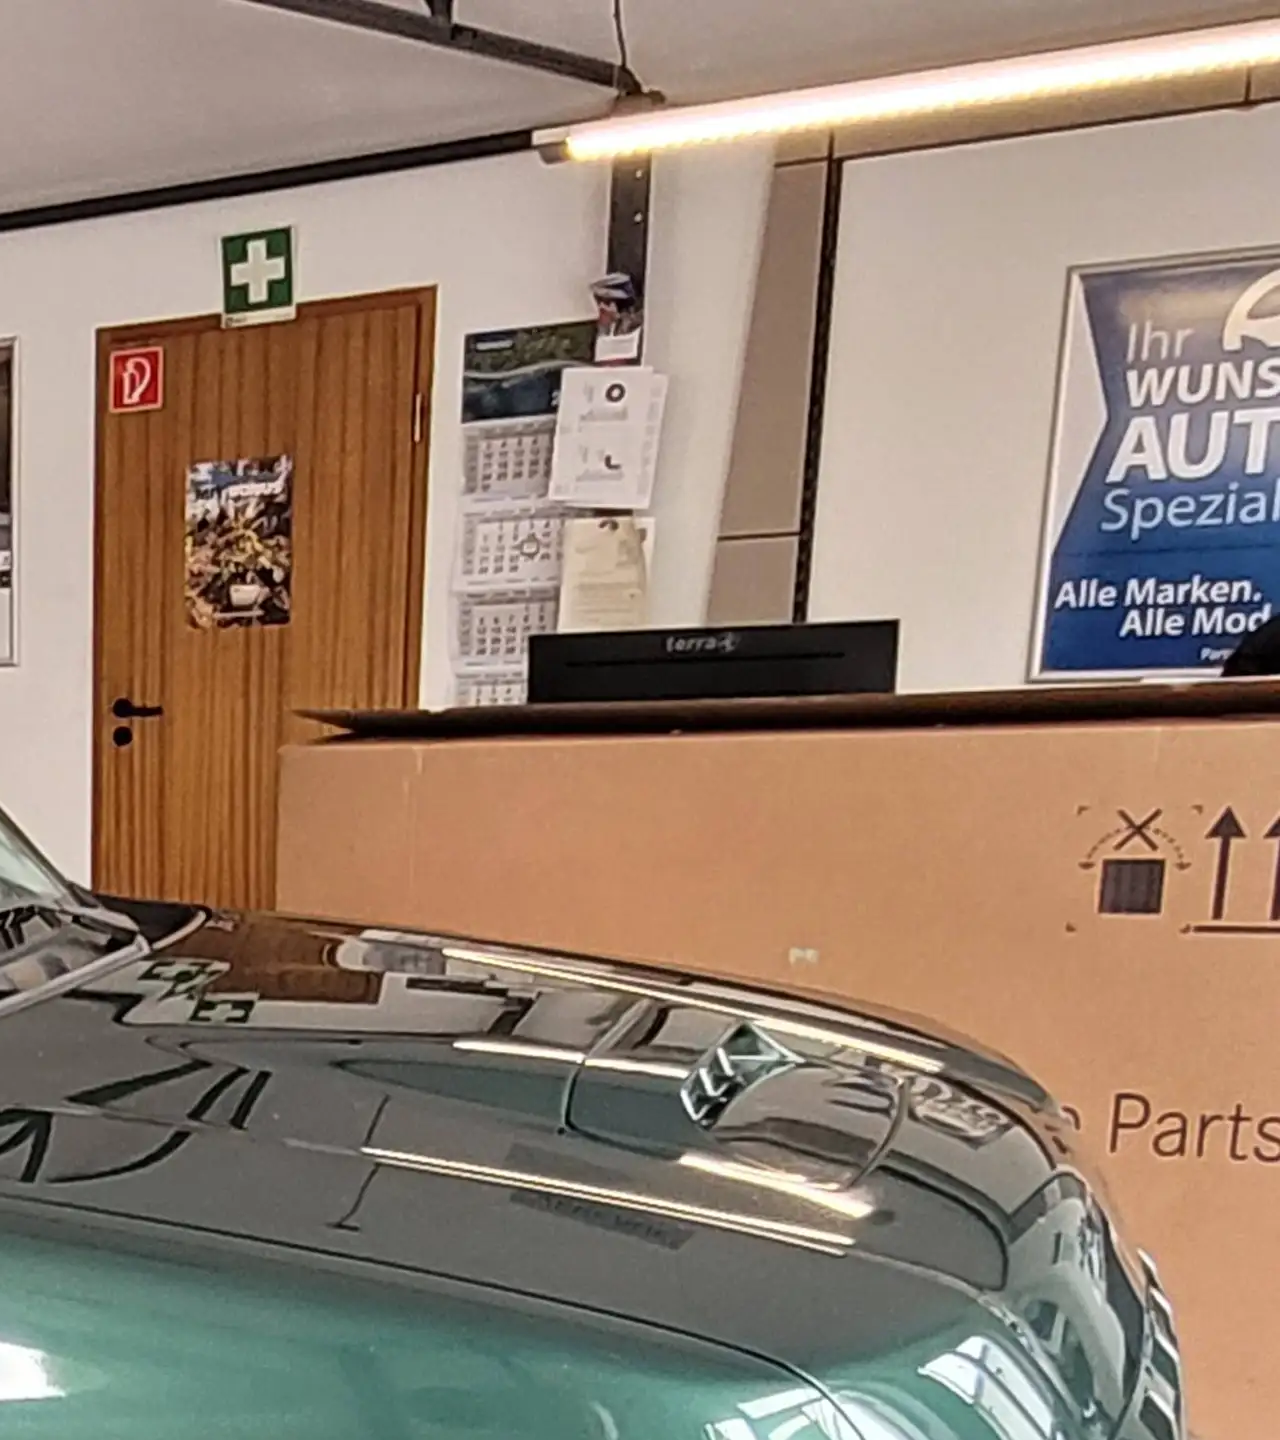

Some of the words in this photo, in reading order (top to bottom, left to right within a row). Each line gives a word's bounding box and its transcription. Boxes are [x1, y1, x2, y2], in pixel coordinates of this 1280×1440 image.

[1126, 320, 1195, 363] Ihr
[1126, 357, 1280, 408] WUNS
[1105, 407, 1280, 484] AUT
[1053, 578, 1117, 609] Alle
[1124, 574, 1263, 606] Marken.
[1119, 607, 1185, 637] Alle
[1109, 1092, 1280, 1163] Parts
